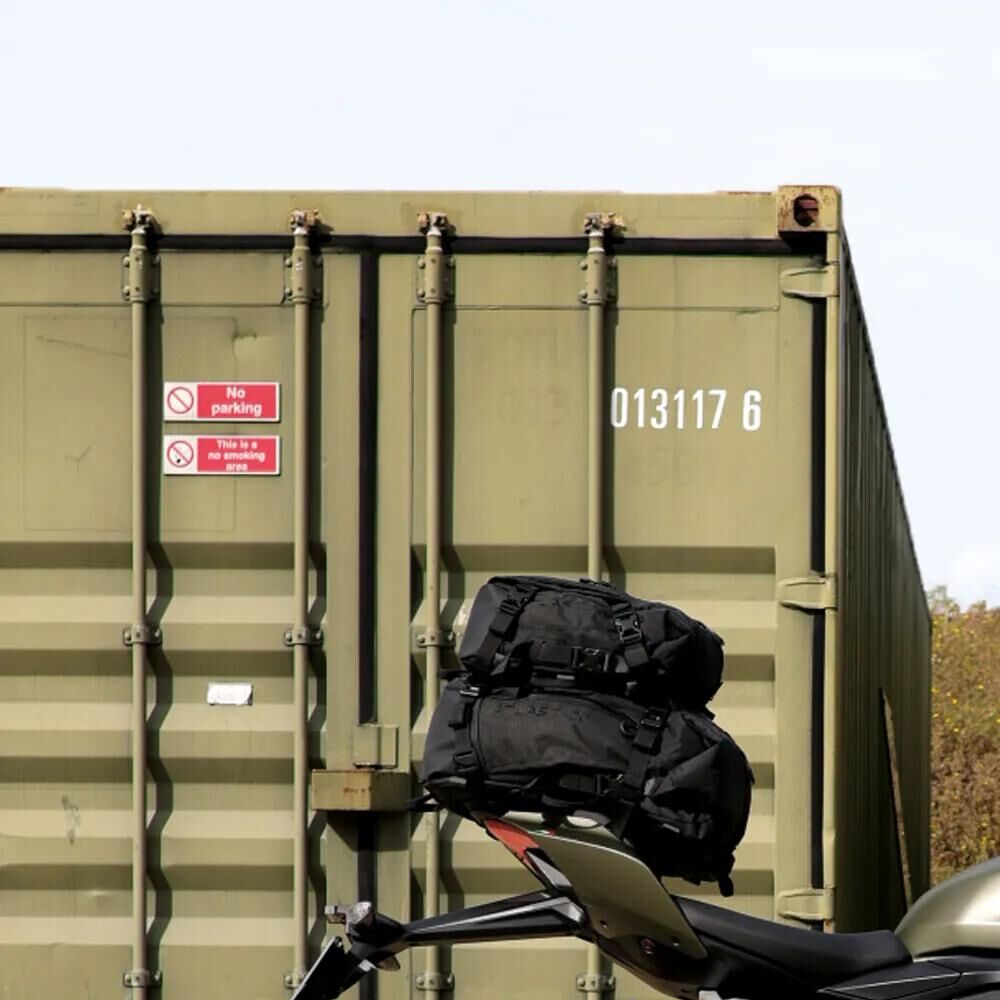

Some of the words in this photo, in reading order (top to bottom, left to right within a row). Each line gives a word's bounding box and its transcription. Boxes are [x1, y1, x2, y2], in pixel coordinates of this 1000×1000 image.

[225, 386, 246, 399] No
[210, 402, 263, 417] parking
[610, 387, 728, 430] 013117
[742, 389, 762, 432] 6
[216, 440, 237, 449] This
[240, 440, 249, 449] is
[207, 452, 221, 460] no
[223, 451, 266, 463] smoking
